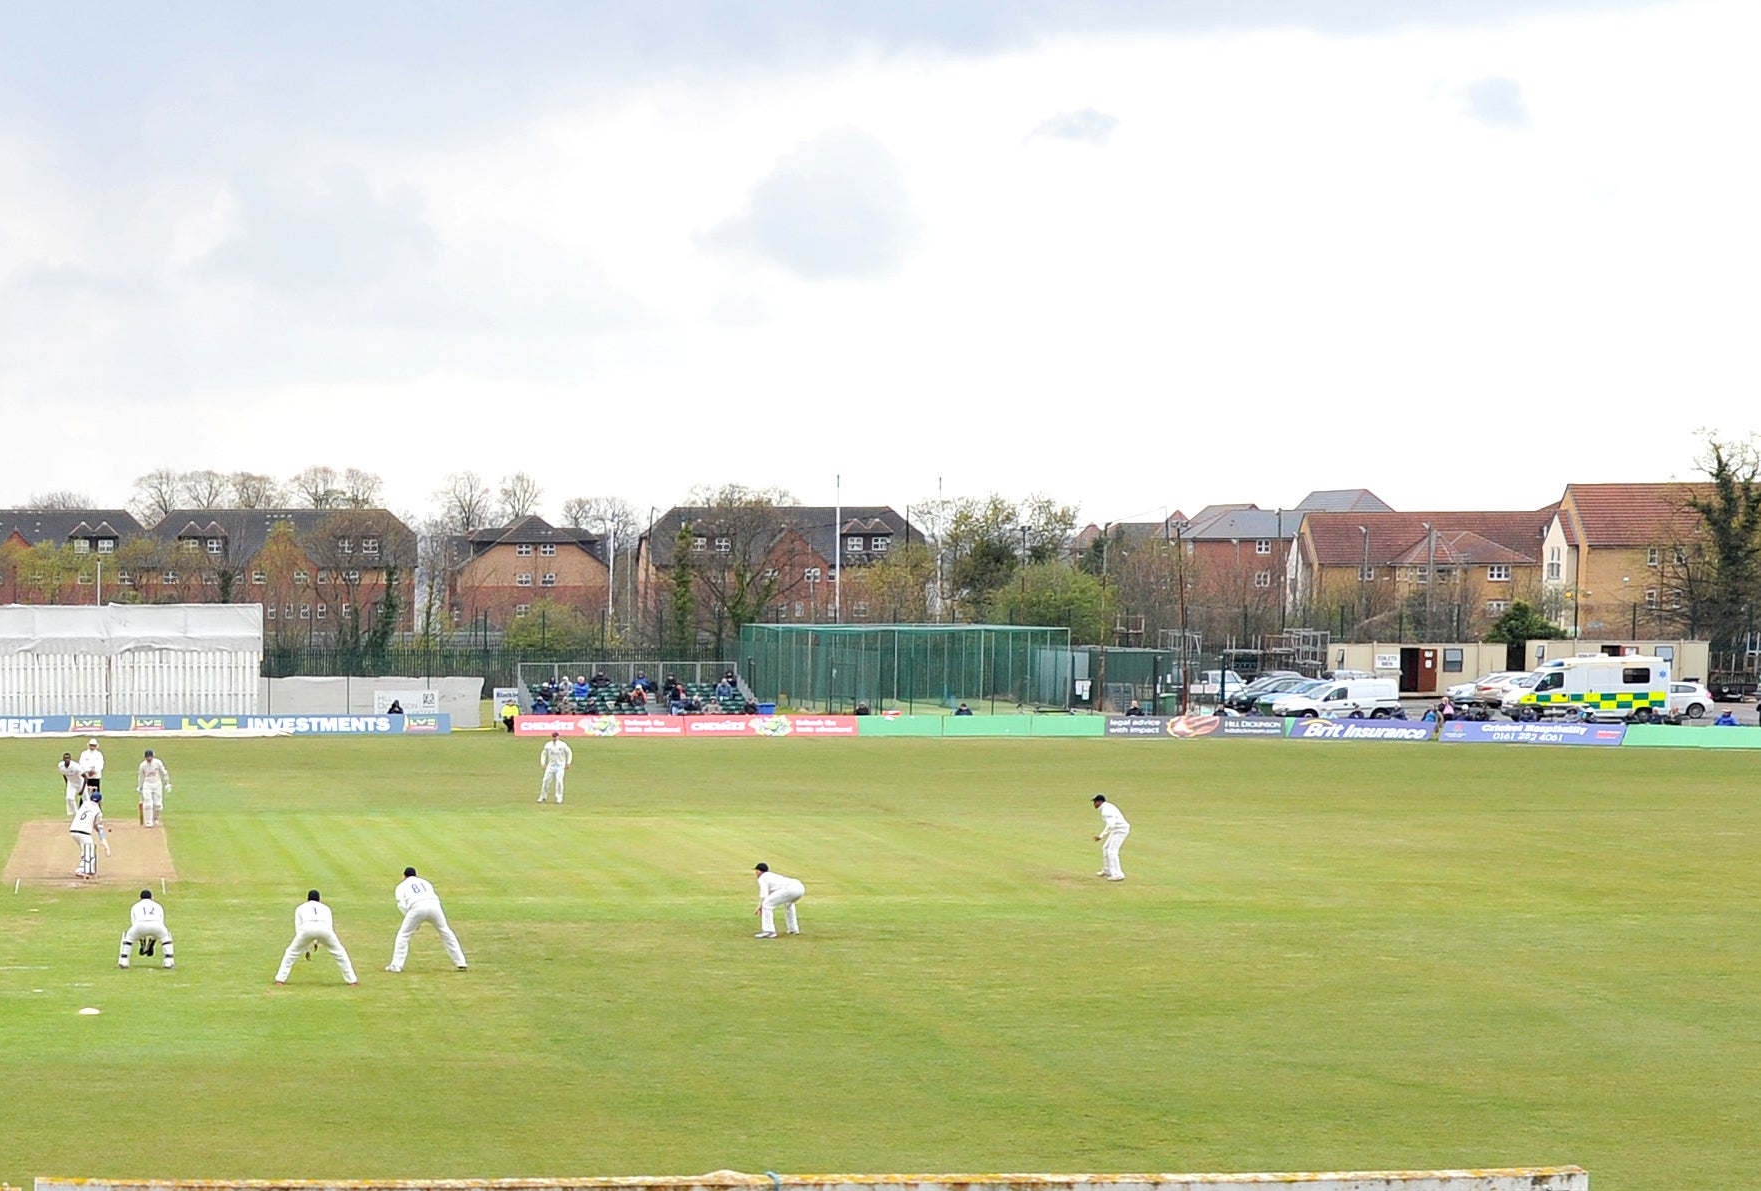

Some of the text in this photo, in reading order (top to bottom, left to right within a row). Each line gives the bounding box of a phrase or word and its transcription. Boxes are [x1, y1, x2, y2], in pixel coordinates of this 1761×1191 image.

[247, 717, 390, 732] INVESTMENTS
[1109, 719, 1131, 727] legal
[1109, 726, 1159, 735] with impact
[1303, 723, 1427, 739] Brit Insurance
[1481, 723, 1523, 733] Cricket
[1525, 724, 1588, 736] Hospitality
[1492, 732, 1515, 741] 0161
